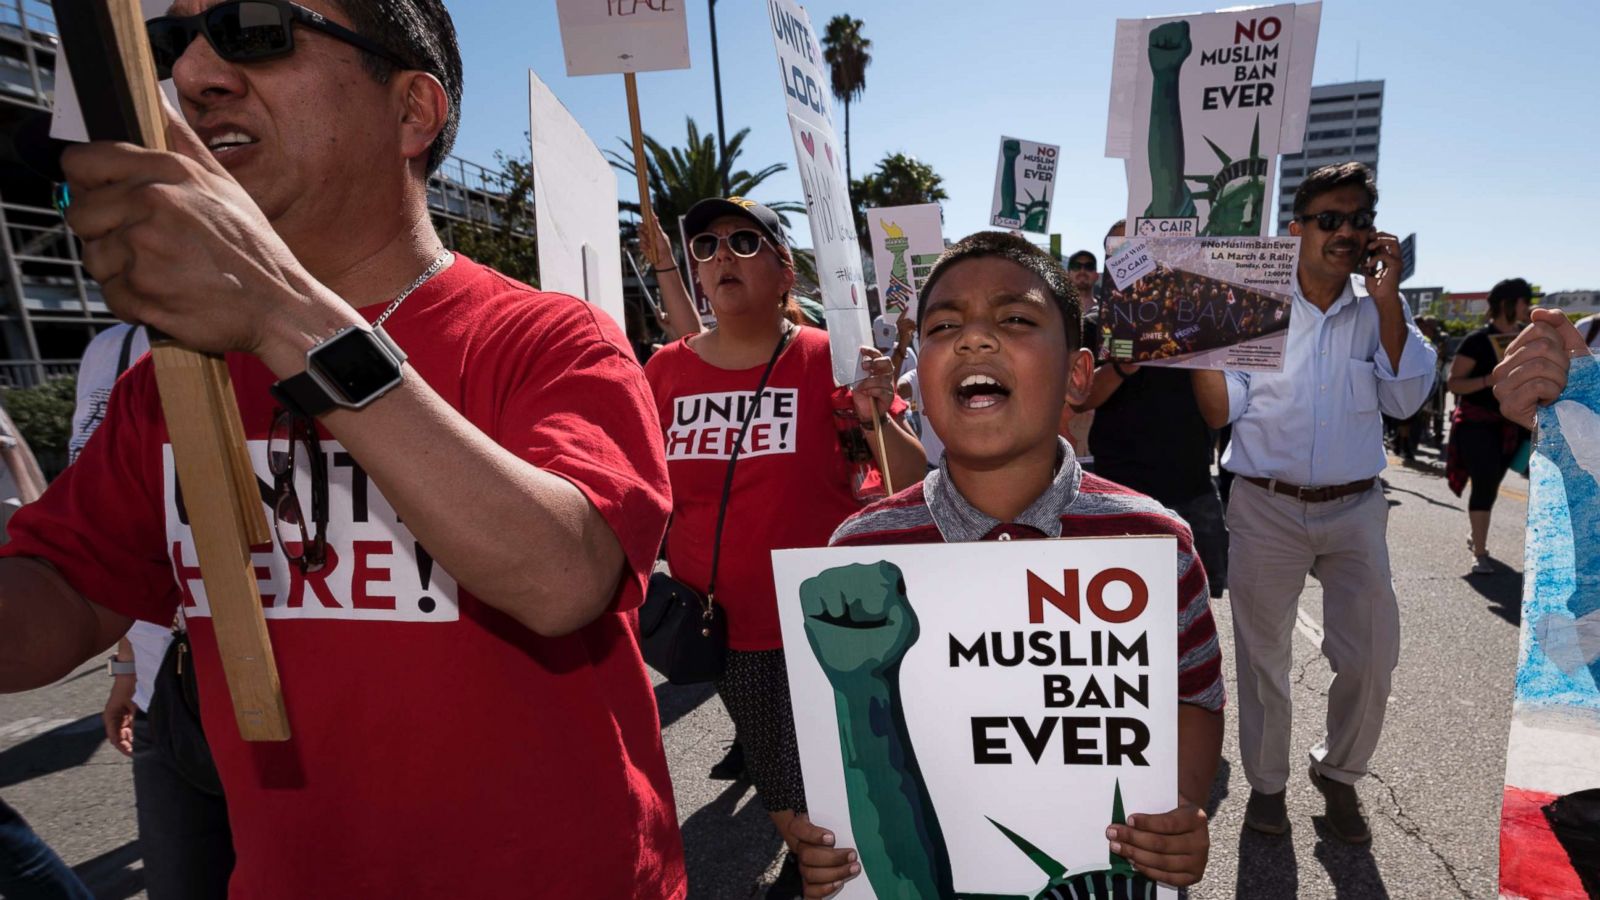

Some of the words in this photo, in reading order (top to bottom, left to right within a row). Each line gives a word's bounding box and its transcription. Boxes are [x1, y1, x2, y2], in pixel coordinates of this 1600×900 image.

[1234, 16, 1282, 45] NO
[1200, 43, 1279, 66] MUSLIM
[1234, 62, 1277, 82] BAN
[1202, 82, 1274, 110] EVER
[1023, 154, 1055, 165] MUSLIM
[1037, 146, 1056, 157] NO
[1023, 168, 1053, 182] EVER
[1159, 220, 1192, 232] CAIR
[1129, 242, 1146, 258] With
[1200, 241, 1296, 250] #NoMuslimBanEver
[1226, 252, 1257, 261] March
[1259, 253, 1266, 261] &
[1269, 252, 1295, 262] Rally
[1127, 254, 1149, 272] CAIR
[1113, 301, 1159, 325] NO
[1177, 300, 1245, 334] BAN
[677, 391, 794, 426] UNITE
[668, 422, 789, 456] HERE!
[1026, 567, 1149, 624] NO
[949, 630, 1149, 667] MUSLIM
[1043, 673, 1149, 709] BAN
[970, 716, 1150, 766] EVER
